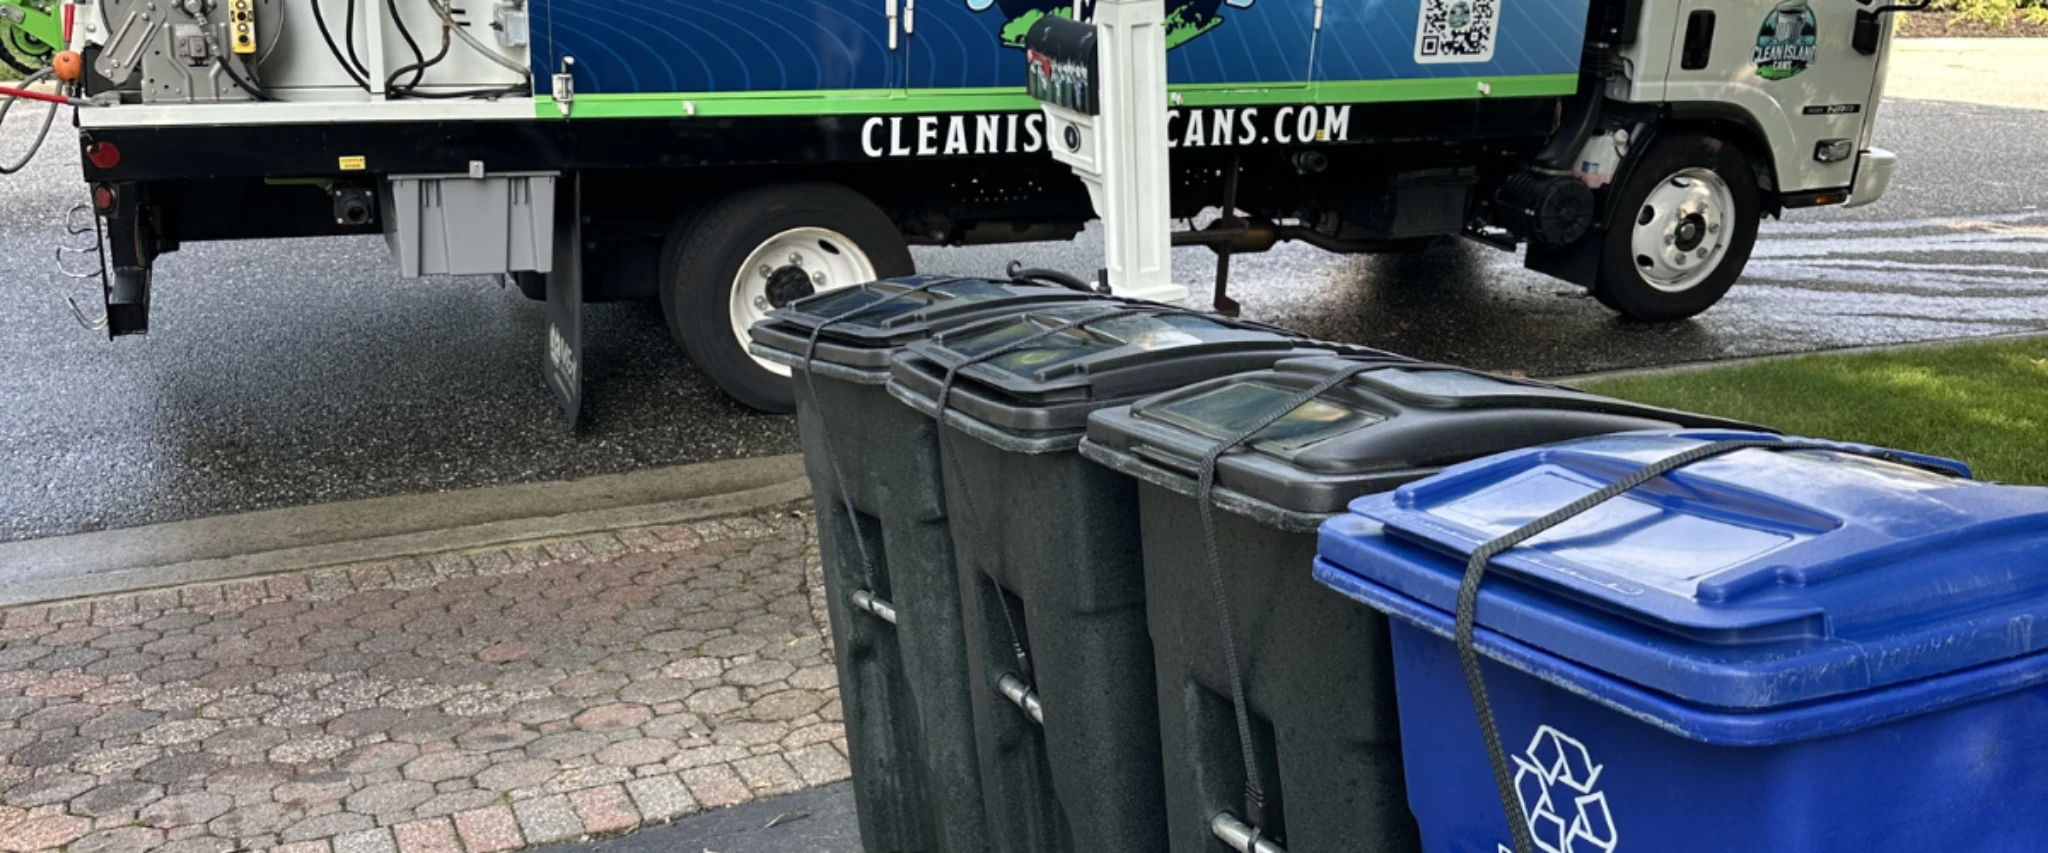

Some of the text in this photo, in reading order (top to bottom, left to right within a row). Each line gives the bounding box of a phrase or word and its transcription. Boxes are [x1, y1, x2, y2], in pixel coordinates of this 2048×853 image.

[1751, 44, 1817, 65] CLEAN ISLAND
[861, 105, 1351, 157] CLEANISCANS.COM
